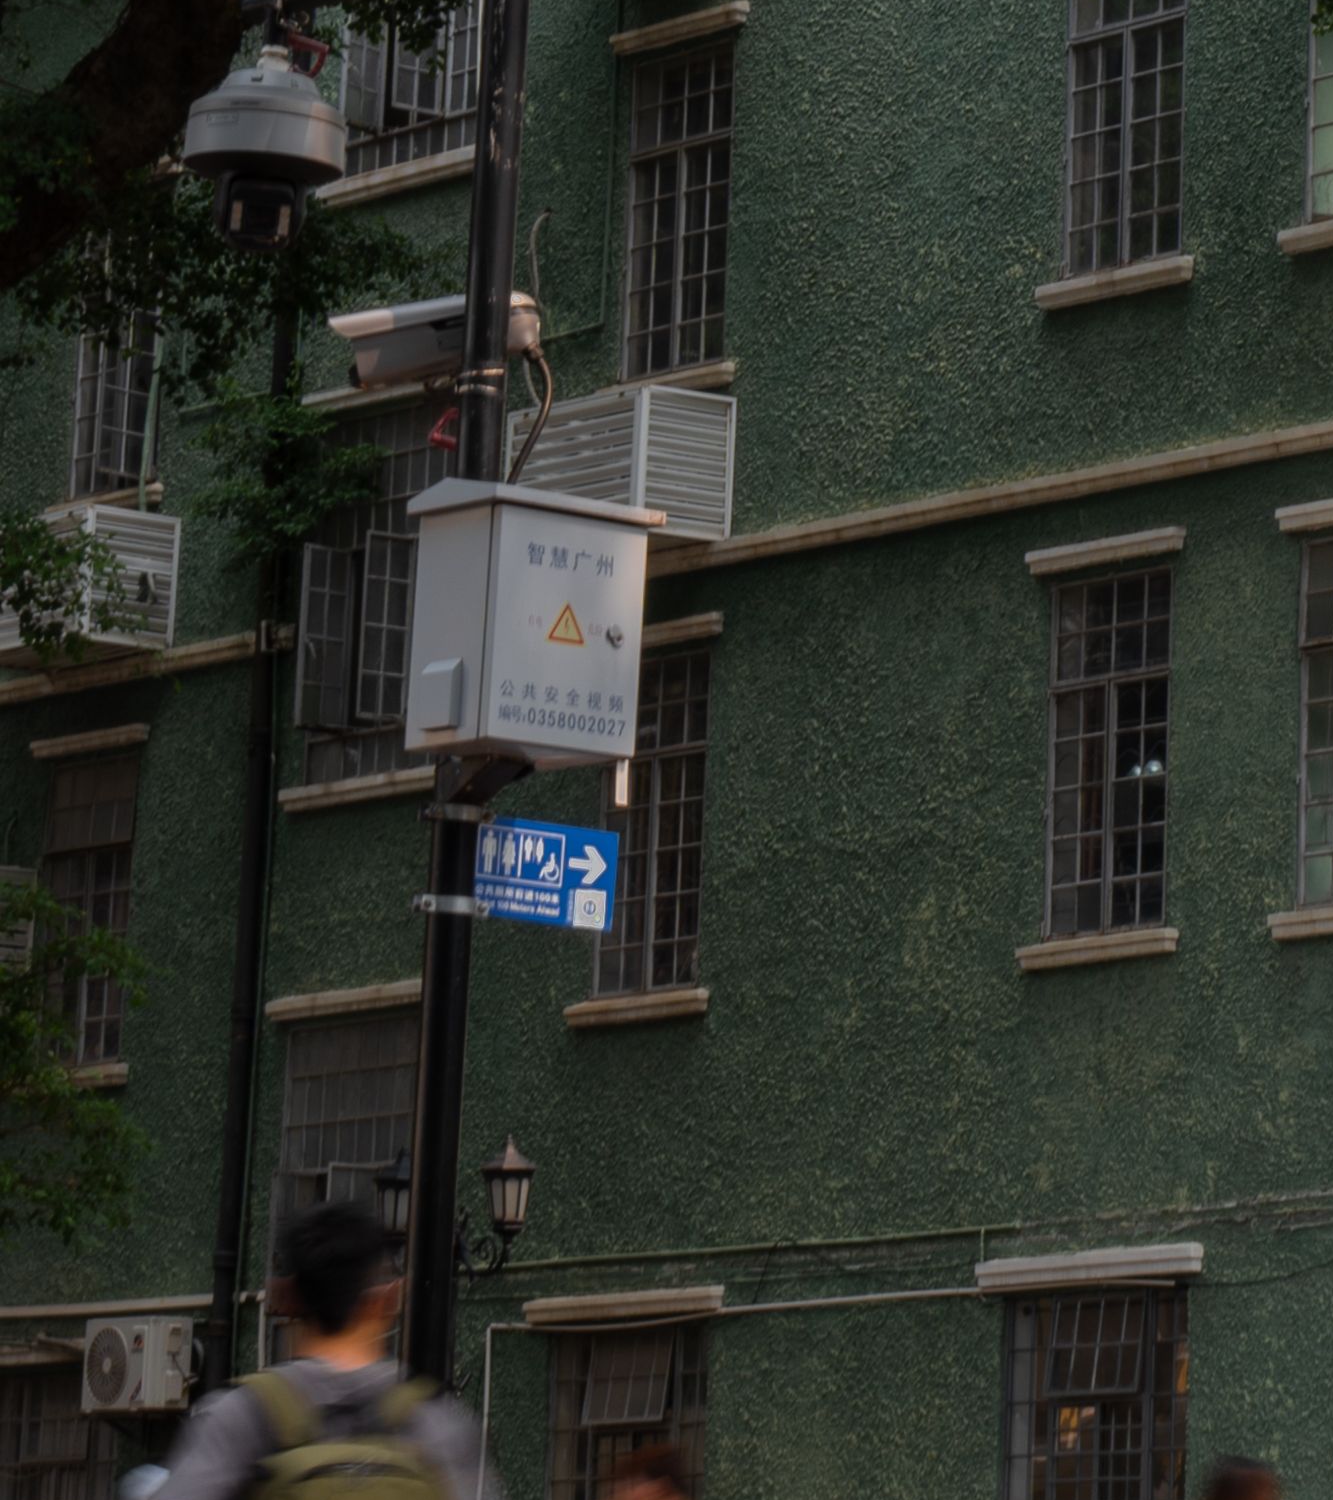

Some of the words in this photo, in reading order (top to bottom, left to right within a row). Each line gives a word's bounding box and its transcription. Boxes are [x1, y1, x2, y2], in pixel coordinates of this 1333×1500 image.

[528, 541, 615, 577] 智慧广州
[500, 679, 624, 713] 公共安全视频
